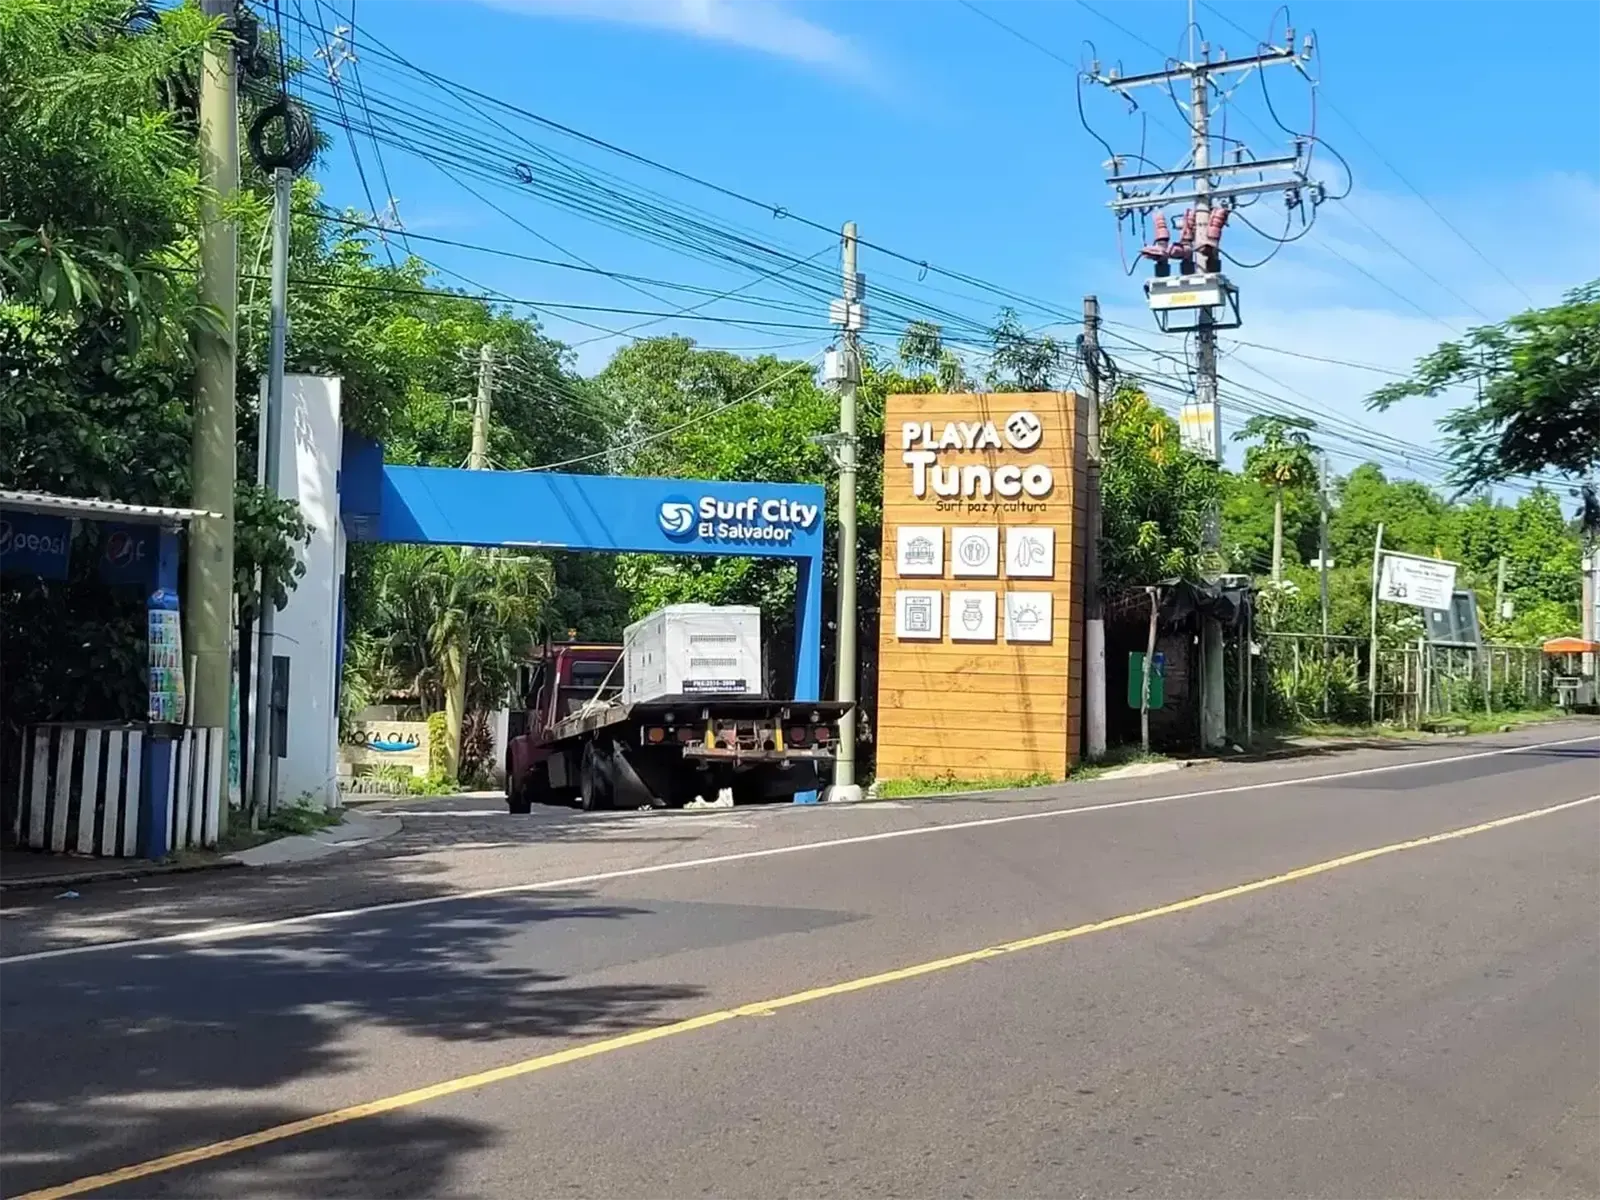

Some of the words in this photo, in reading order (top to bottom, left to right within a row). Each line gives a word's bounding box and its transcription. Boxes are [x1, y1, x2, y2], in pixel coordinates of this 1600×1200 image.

[902, 421, 1002, 450] PLAYA
[1008, 416, 1039, 441] EL
[902, 451, 1053, 496] Tunco
[700, 496, 758, 520] Surf
[762, 499, 818, 527] City
[936, 500, 963, 512] Surf
[967, 502, 989, 515] paz
[992, 502, 1000, 514] y
[1003, 500, 1047, 512] cultura
[14, 532, 65, 555] pepsi
[698, 522, 715, 538] El
[719, 522, 793, 540] Salvador
